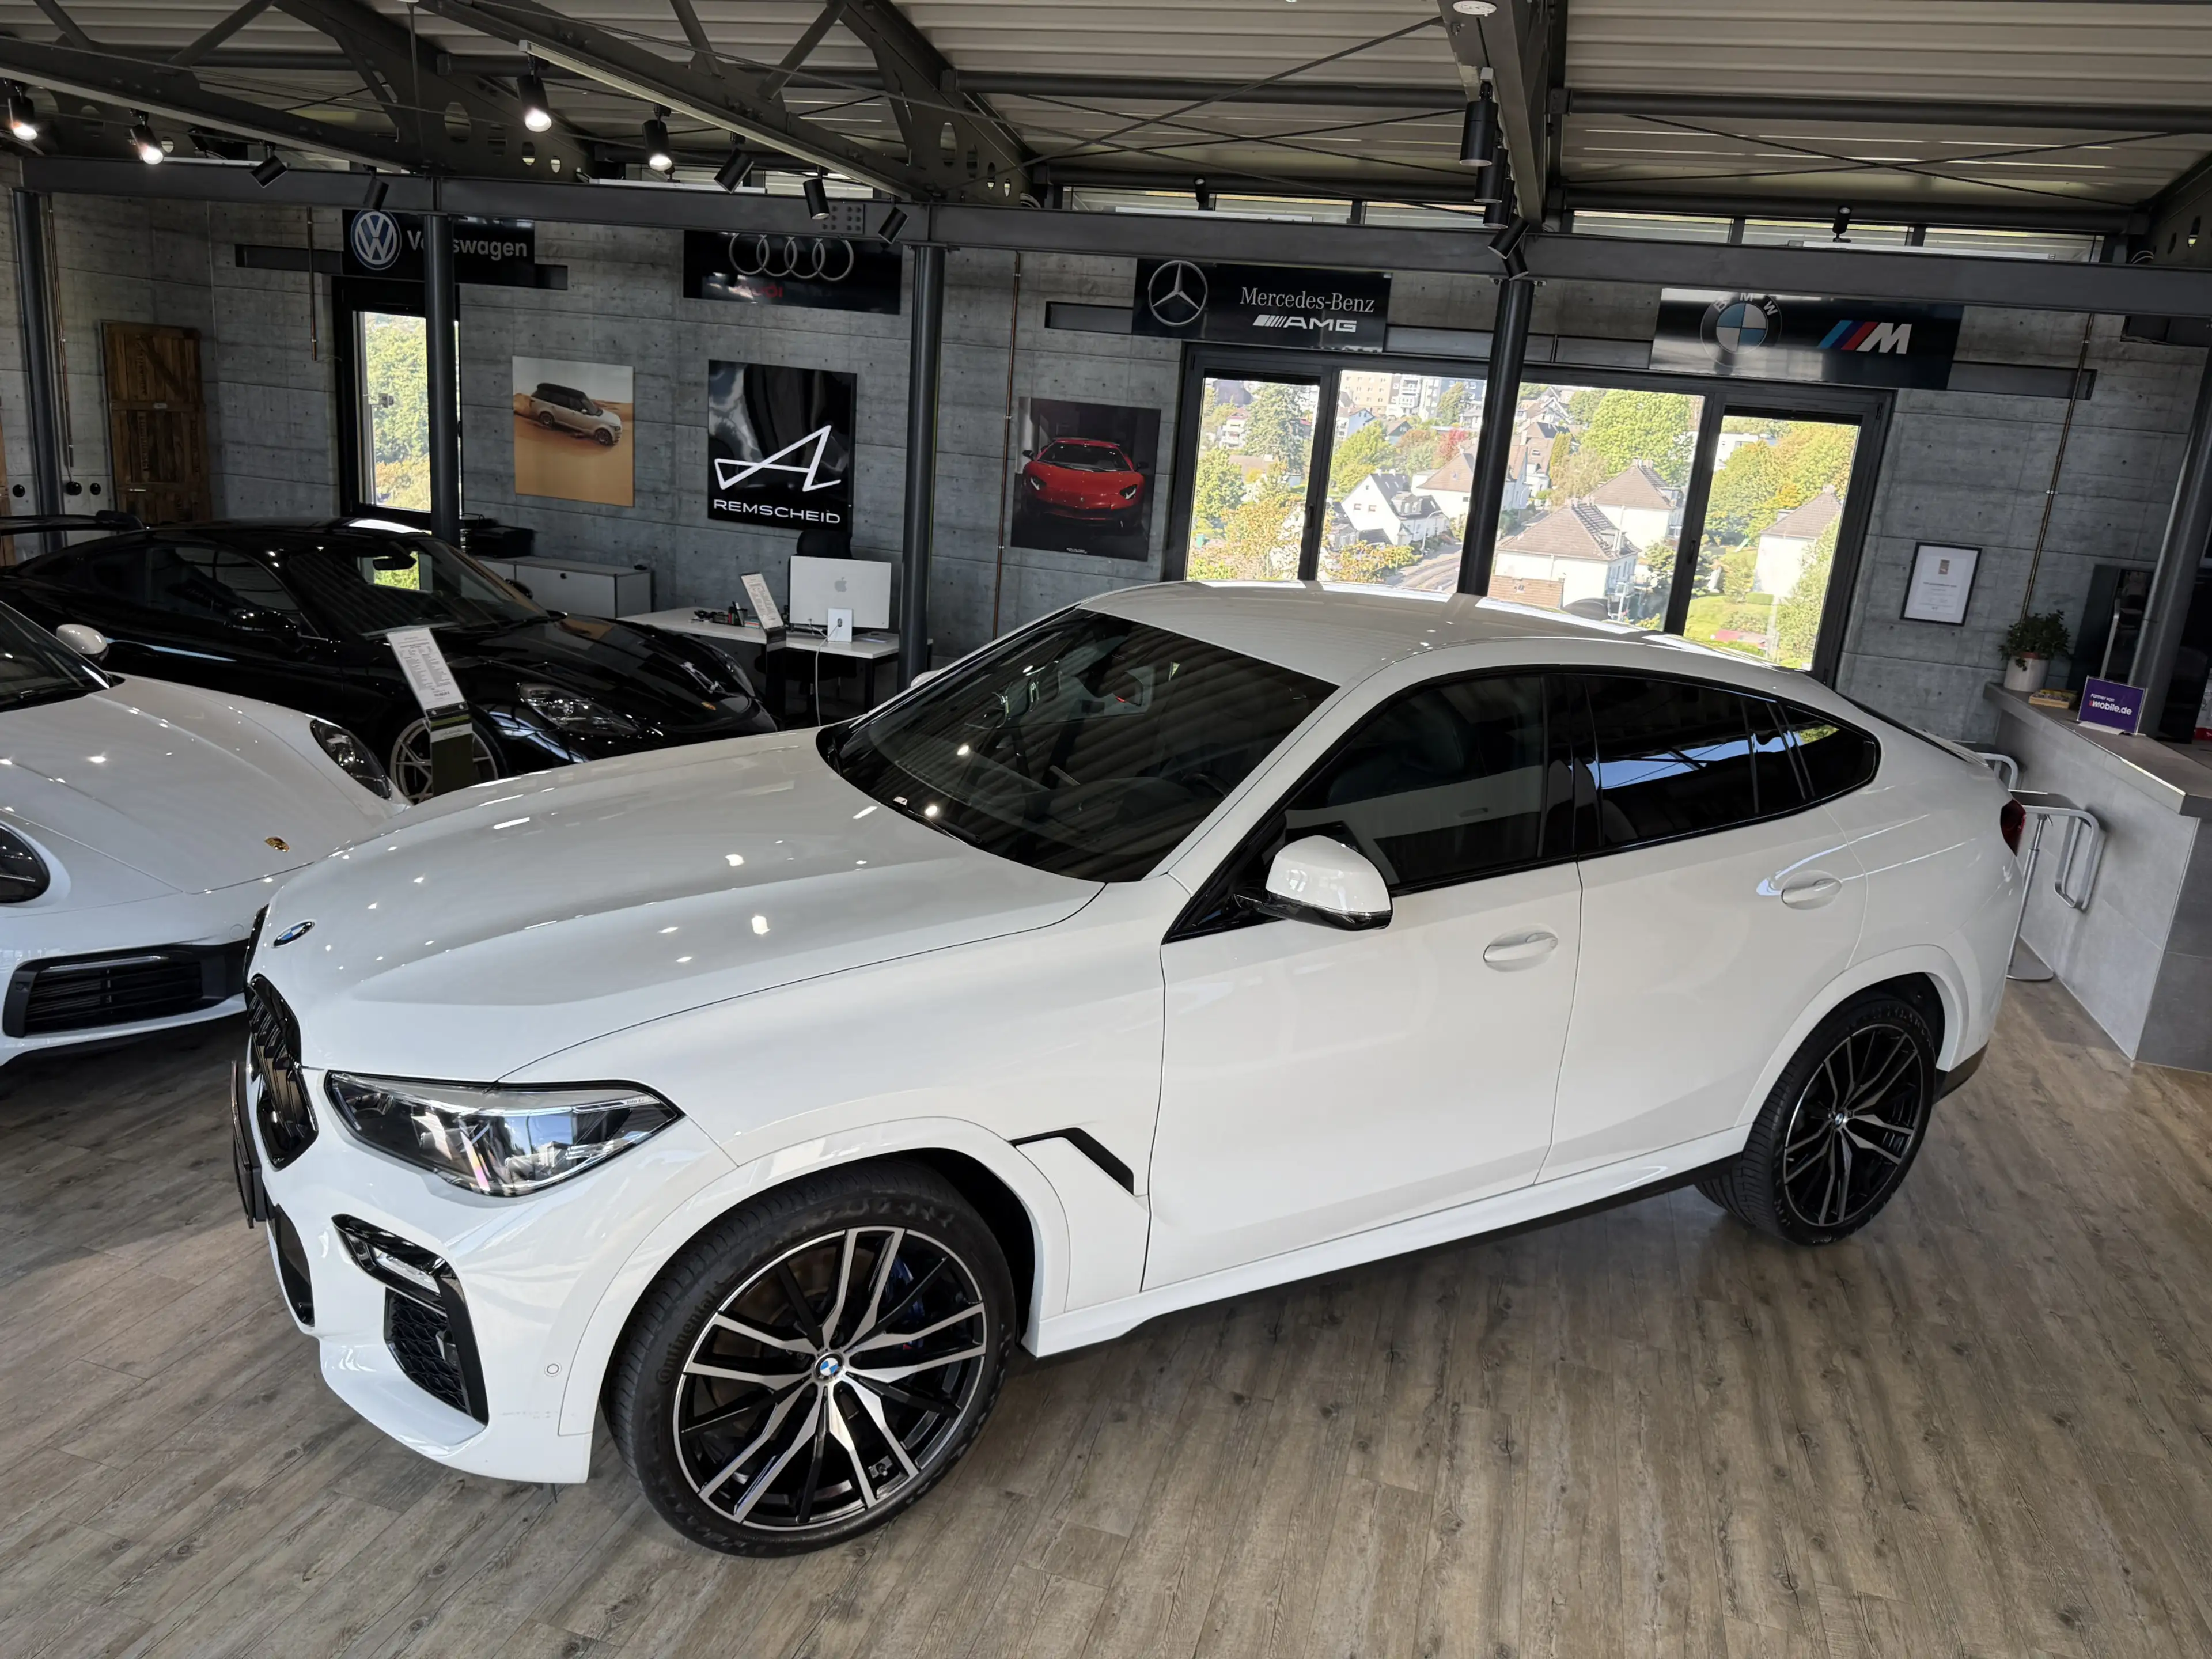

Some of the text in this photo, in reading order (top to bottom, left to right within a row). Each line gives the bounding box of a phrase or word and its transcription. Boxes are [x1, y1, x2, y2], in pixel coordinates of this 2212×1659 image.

[407, 230, 527, 259] Vswagen
[1240, 287, 1375, 313] Mercedes-Benz
[714, 499, 840, 524] REMSCHEID
[2091, 700, 2133, 715] mobile.de
[656, 1289, 717, 1386] Continental
